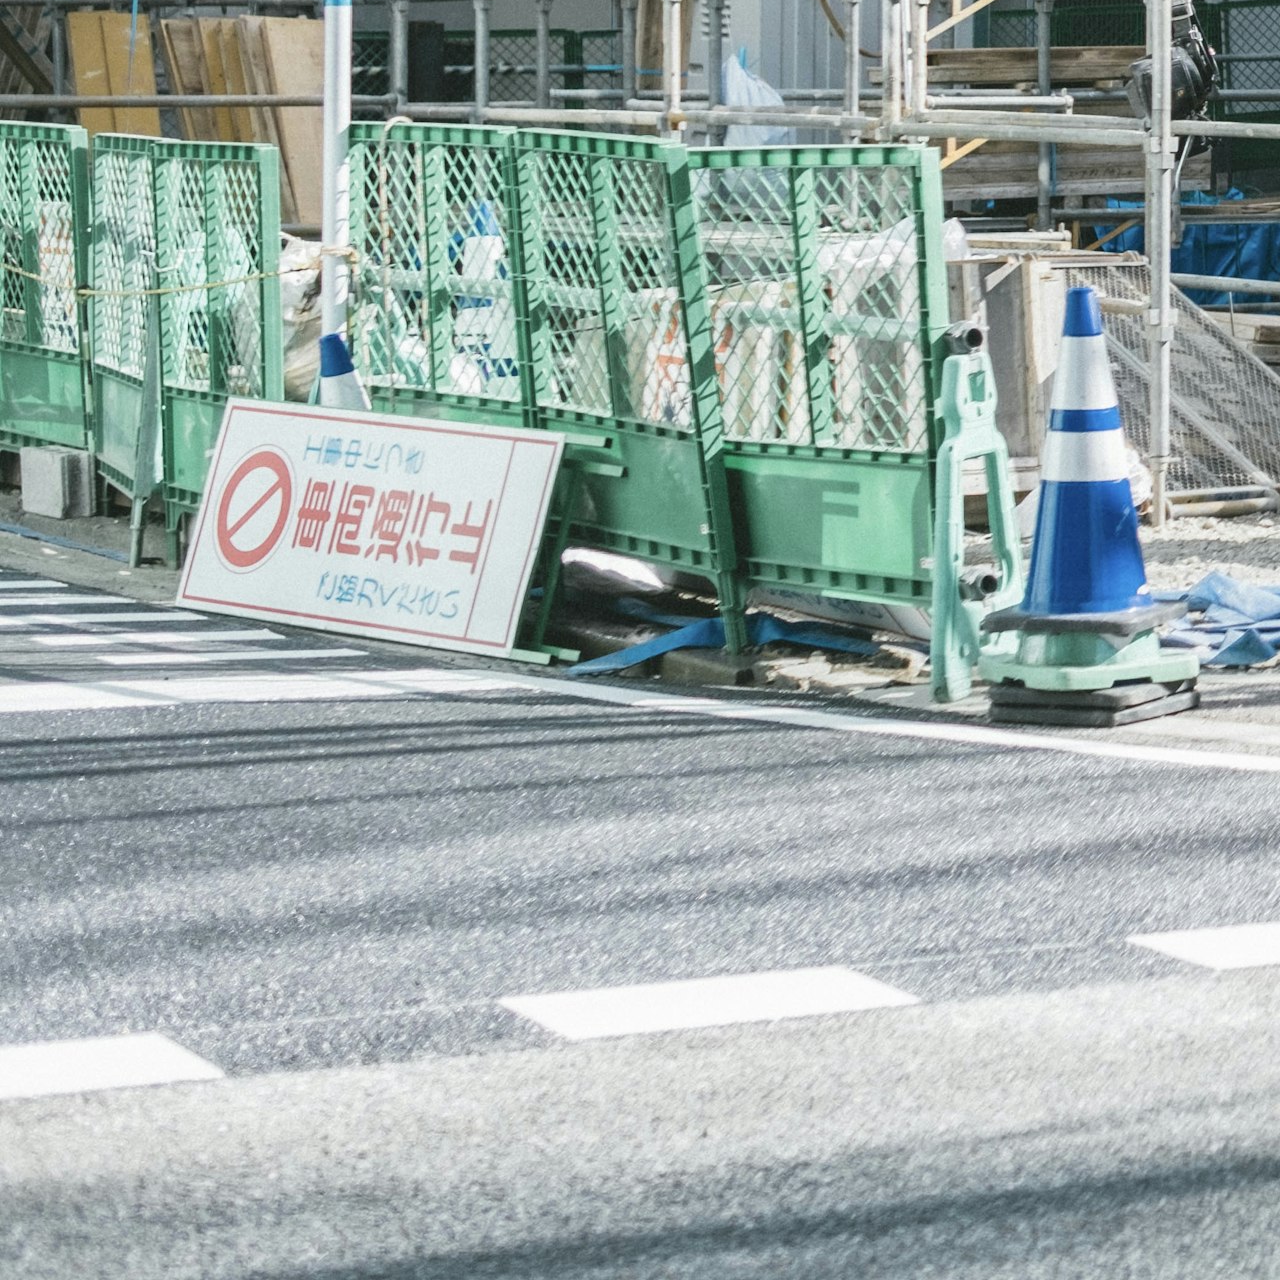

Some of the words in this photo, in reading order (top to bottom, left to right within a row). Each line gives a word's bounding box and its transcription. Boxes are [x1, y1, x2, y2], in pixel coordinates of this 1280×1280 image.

[304, 435, 425, 474] 工事中につき
[292, 478, 492, 574] 車両通行止
[317, 571, 460, 618] ご協力ください
